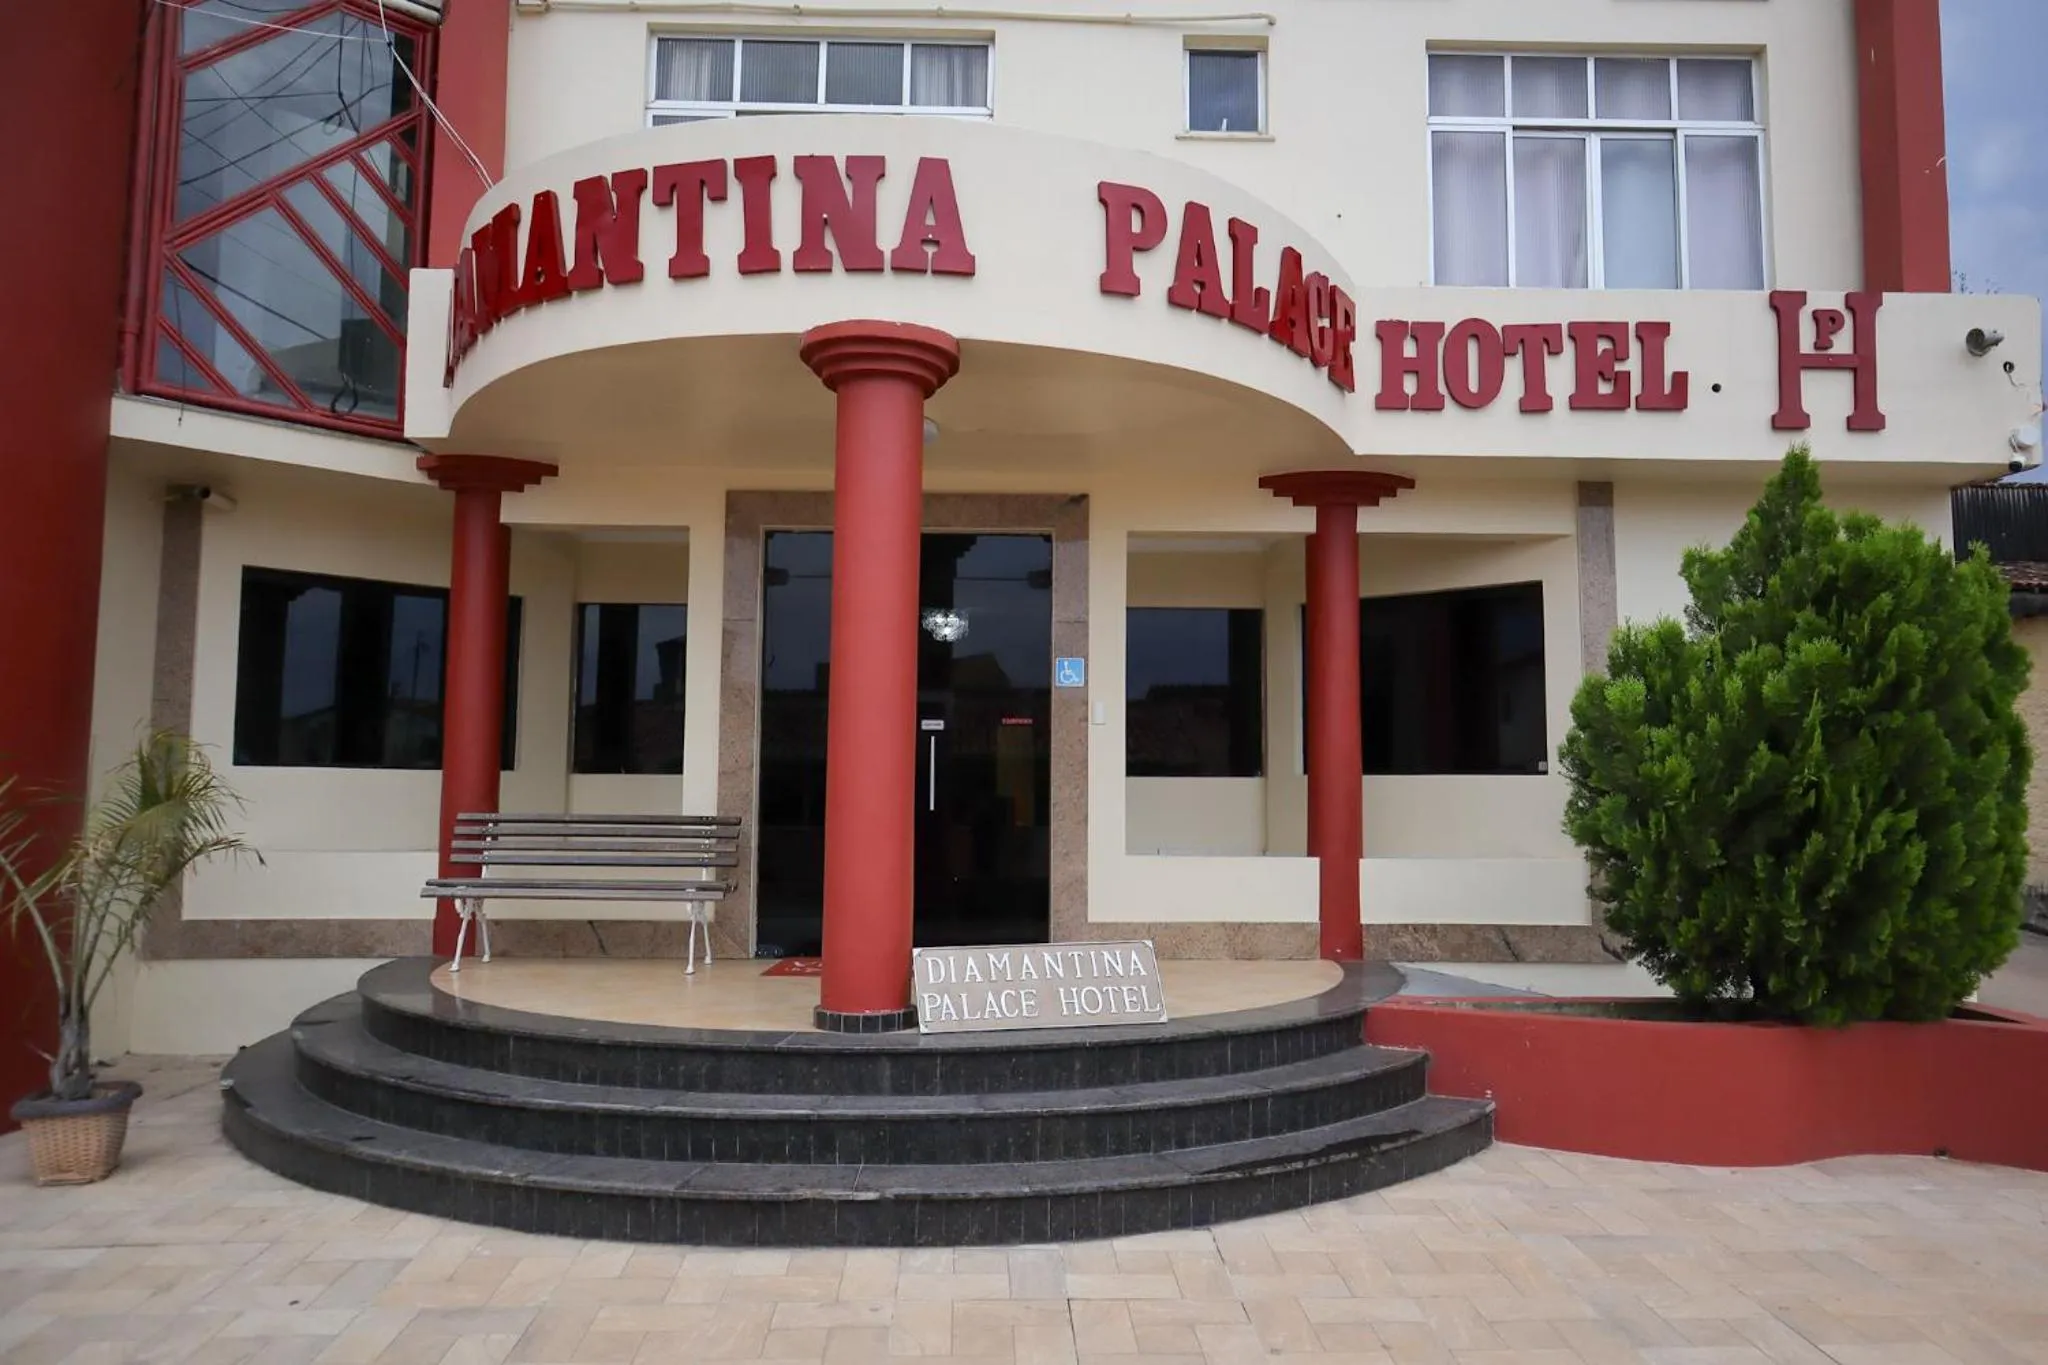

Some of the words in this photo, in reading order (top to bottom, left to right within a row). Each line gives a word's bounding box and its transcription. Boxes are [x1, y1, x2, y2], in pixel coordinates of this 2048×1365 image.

[1098, 182, 1356, 393] PALACE
[1375, 318, 1689, 413] HOTEL
[926, 949, 1148, 984] DIAMANTINA
[922, 988, 1040, 1022] PALACE
[1059, 984, 1161, 1017] HOTEL
